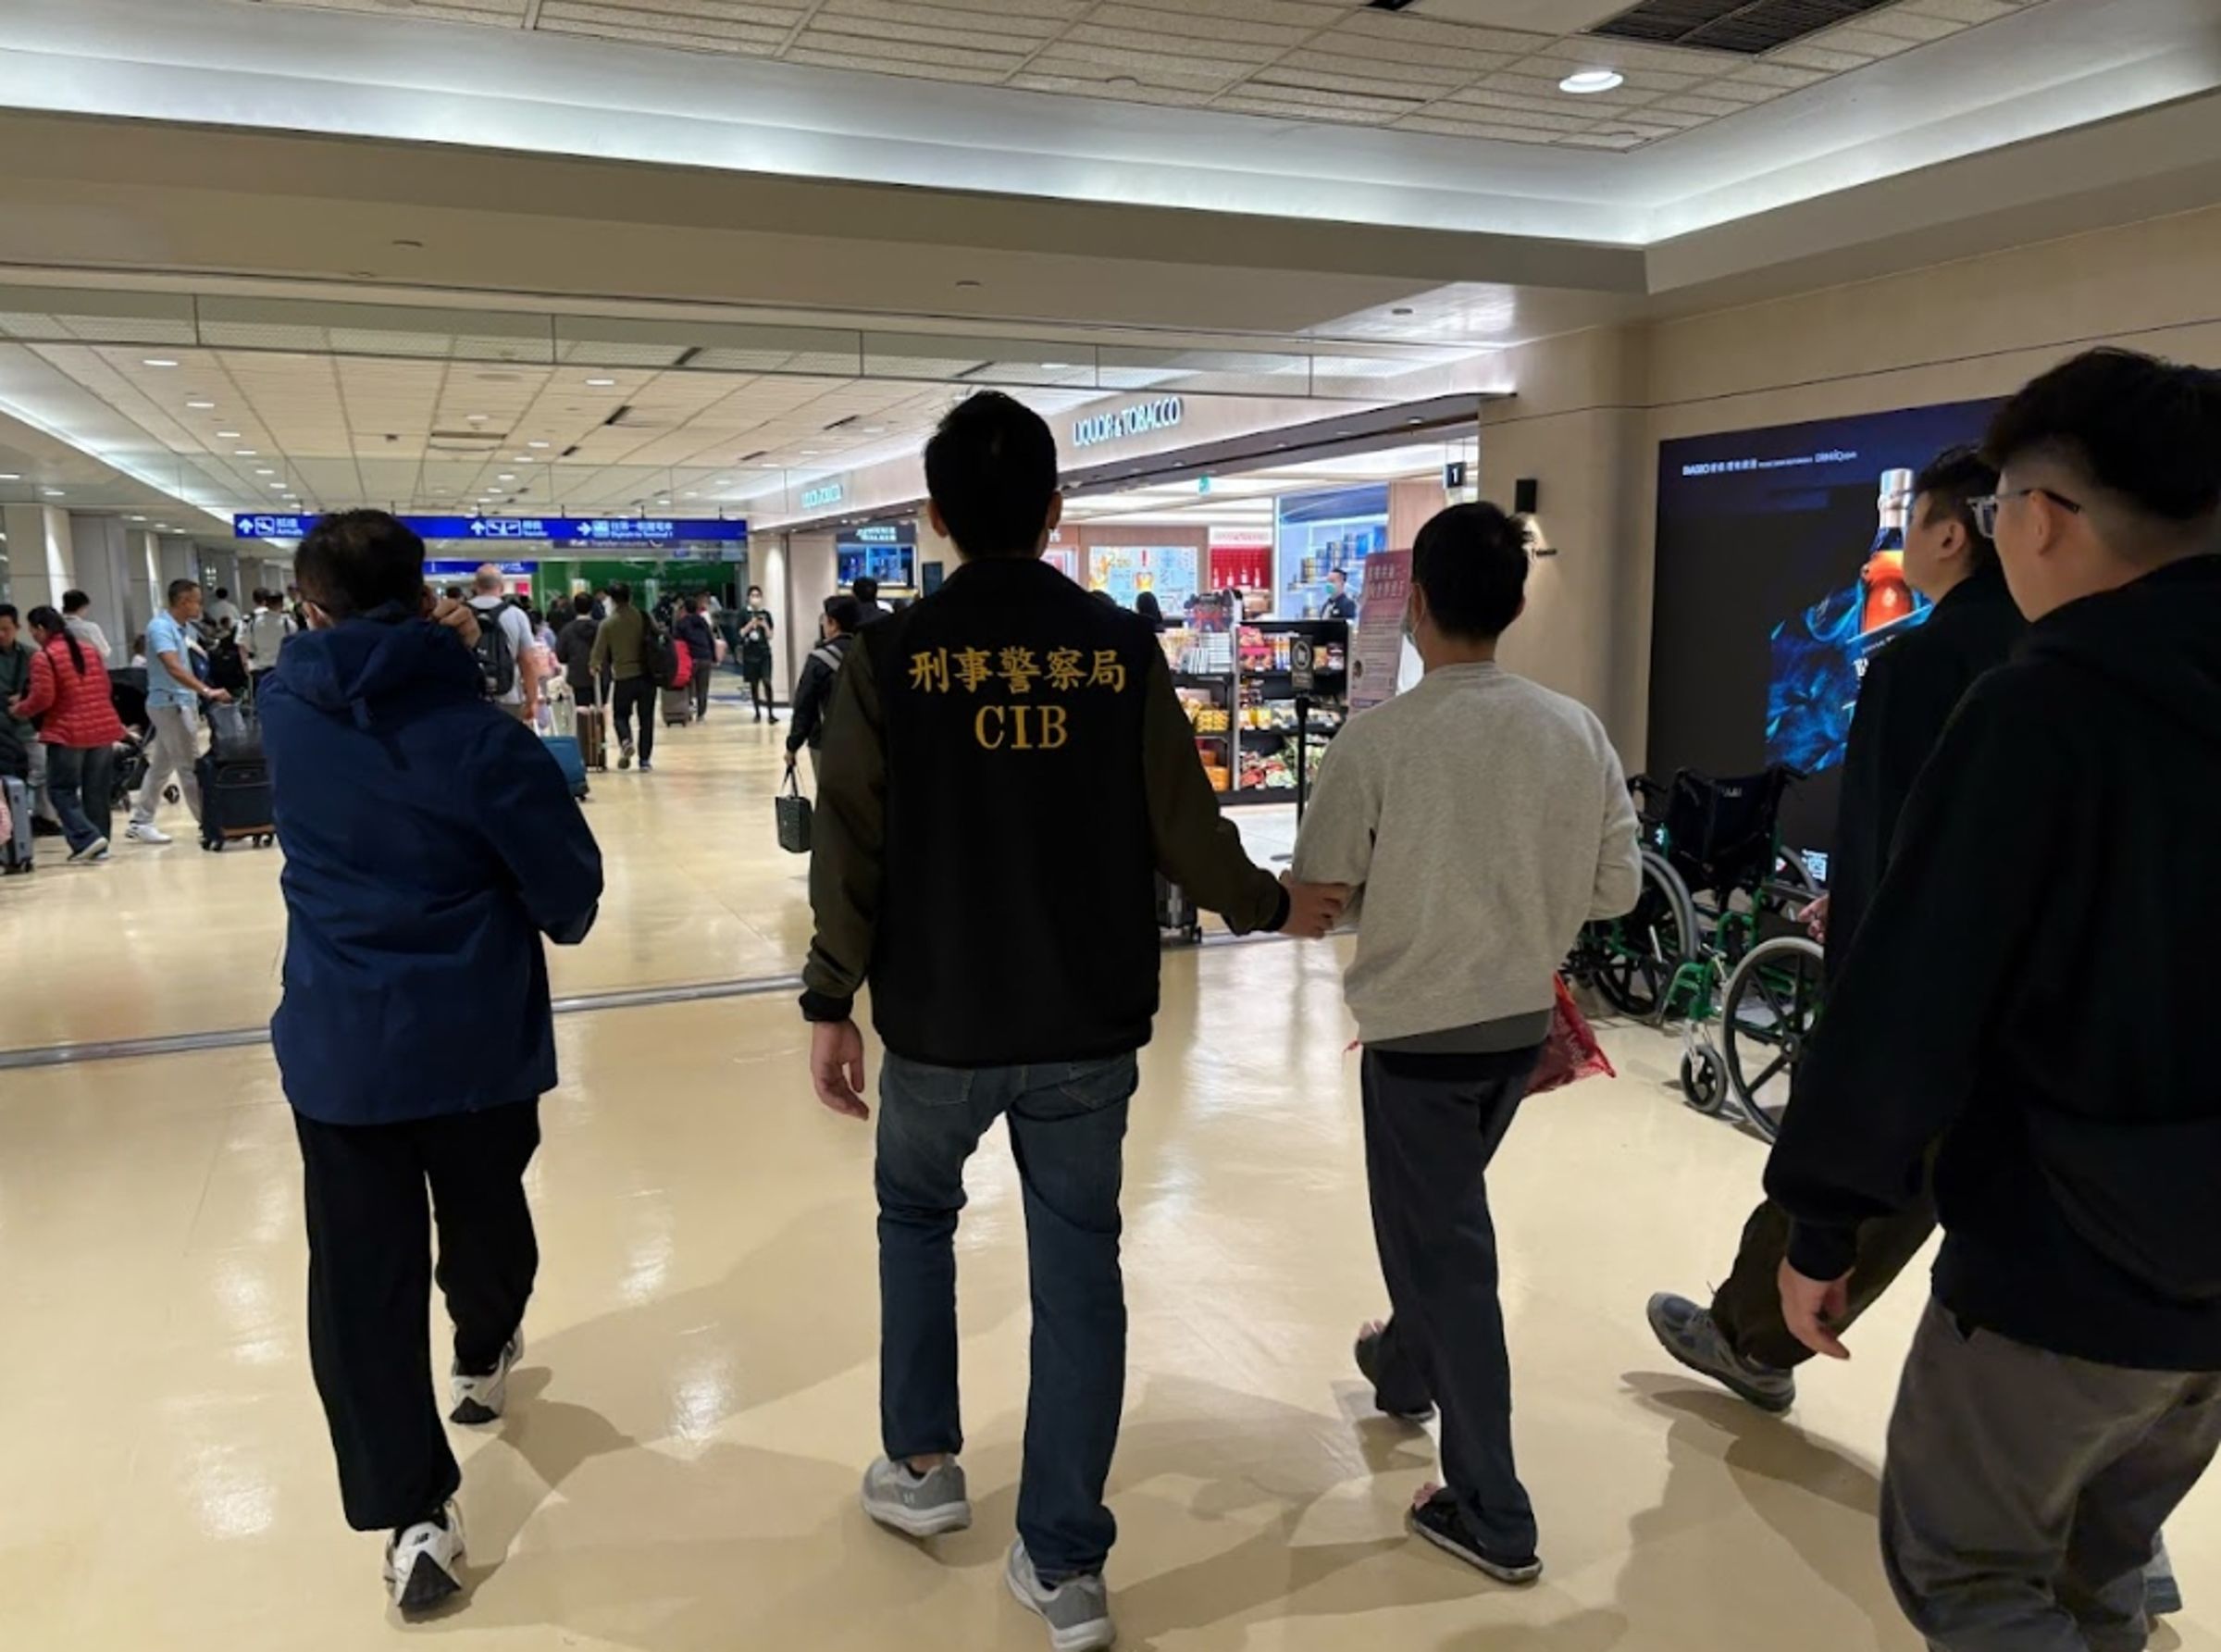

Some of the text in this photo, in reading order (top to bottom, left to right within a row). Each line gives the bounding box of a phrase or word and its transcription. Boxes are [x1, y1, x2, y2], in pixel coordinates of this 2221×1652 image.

[1073, 414, 1113, 446] LIQUOR
[1122, 397, 1181, 435] TOBACCO
[1452, 467, 1458, 483] 1
[909, 646, 1126, 694] 刑事警察局
[975, 705, 1068, 750] CIB
